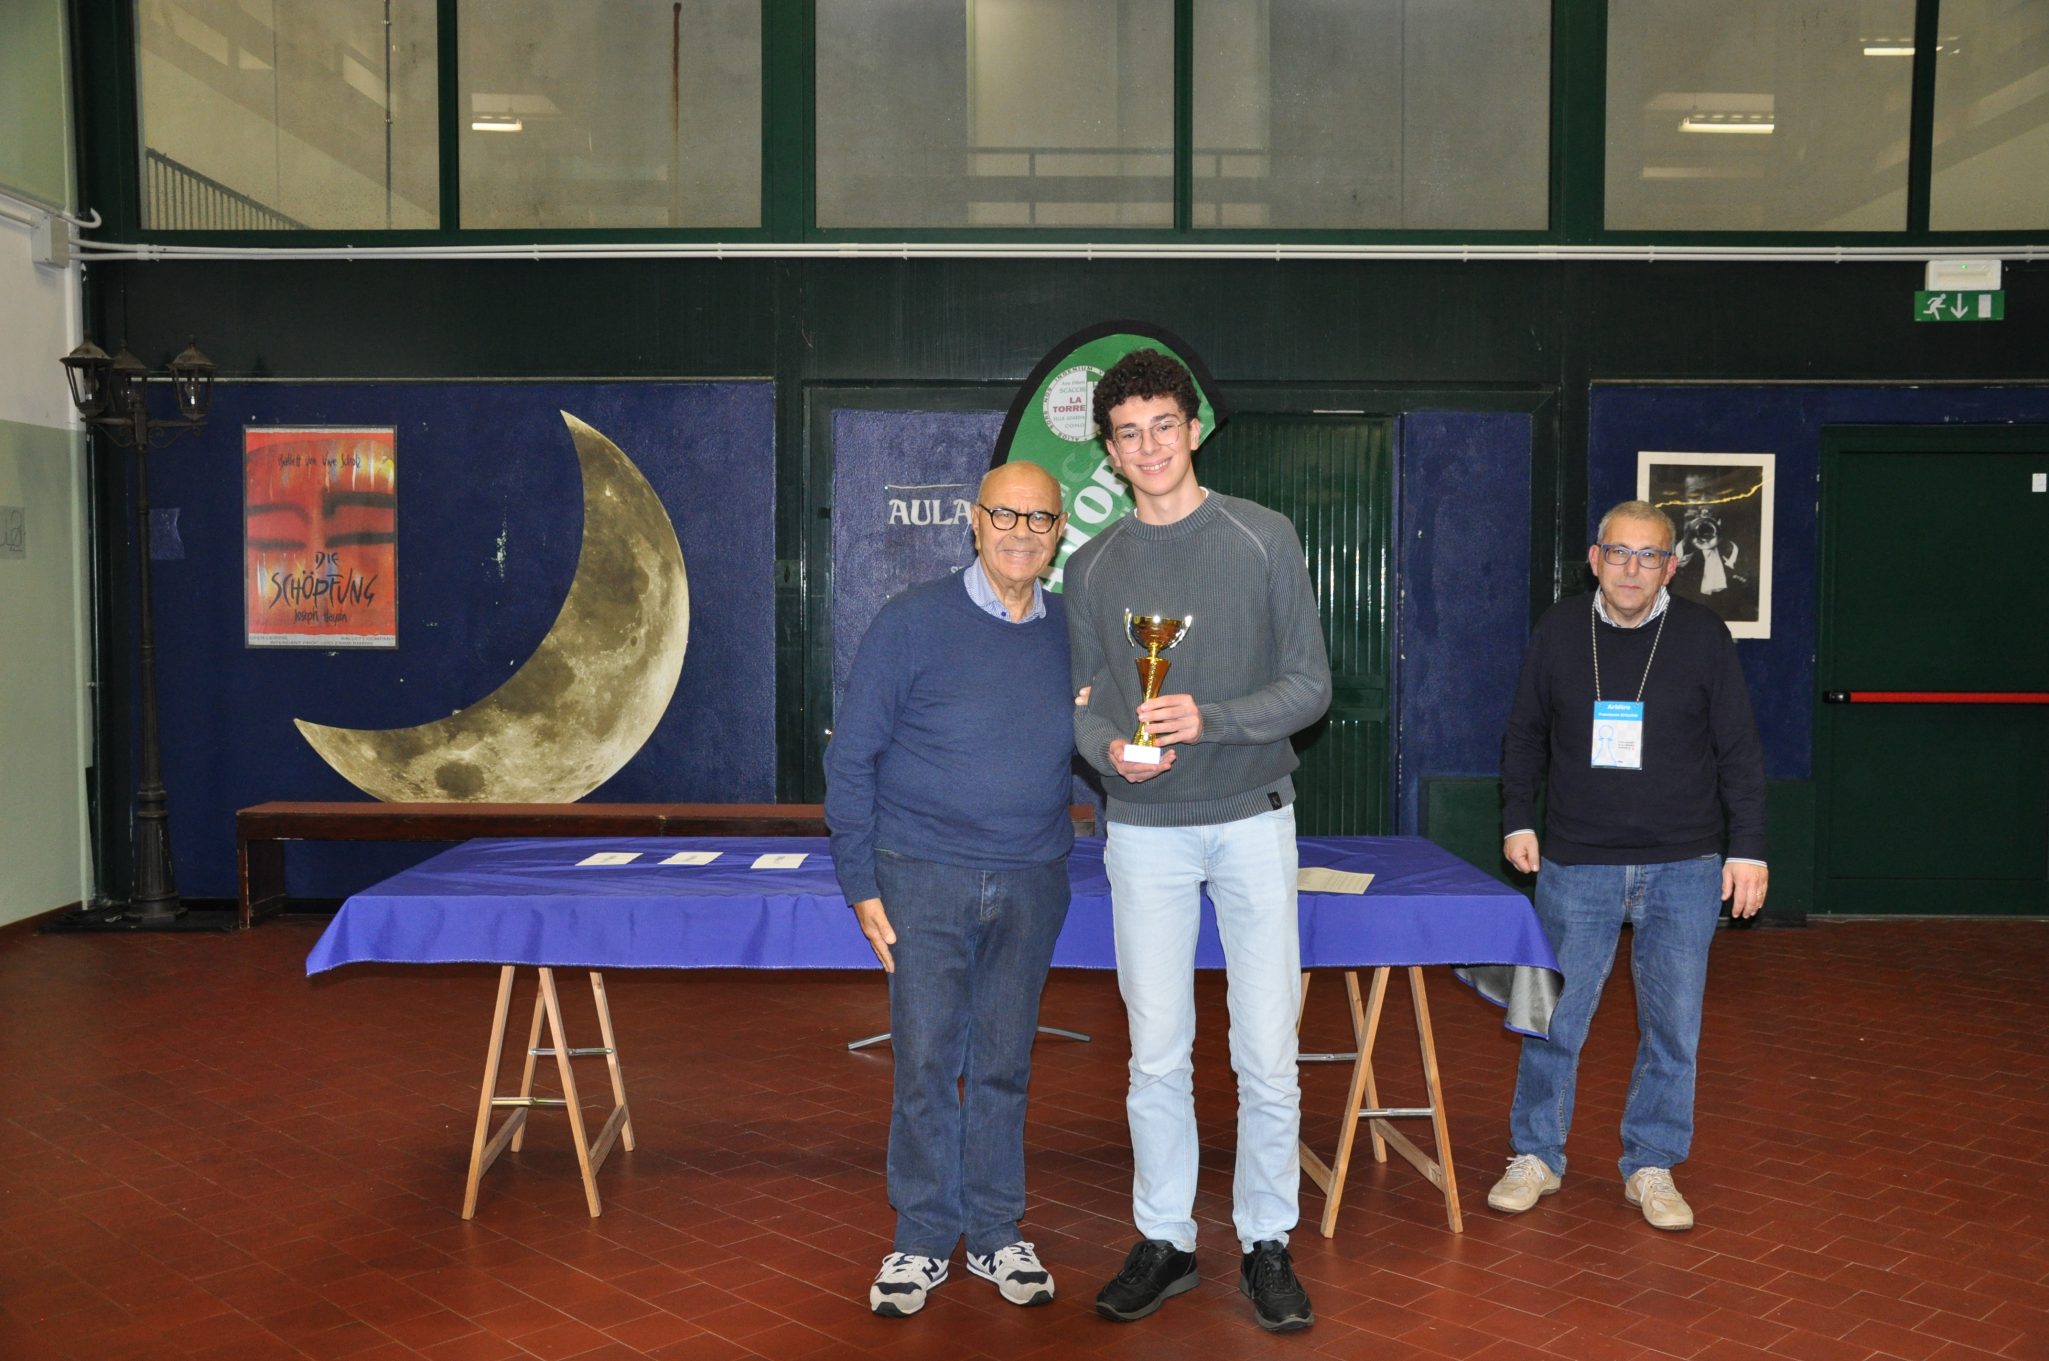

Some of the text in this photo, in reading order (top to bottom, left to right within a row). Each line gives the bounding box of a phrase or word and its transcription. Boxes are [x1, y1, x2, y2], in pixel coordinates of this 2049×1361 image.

[1053, 404, 1087, 413] TORRE
[1069, 396, 1082, 404] LA
[888, 498, 972, 526] AULA
[315, 552, 339, 569] DIE
[269, 568, 378, 608] SCHÖPFUNG
[293, 606, 348, 626] Joseph Haydn
